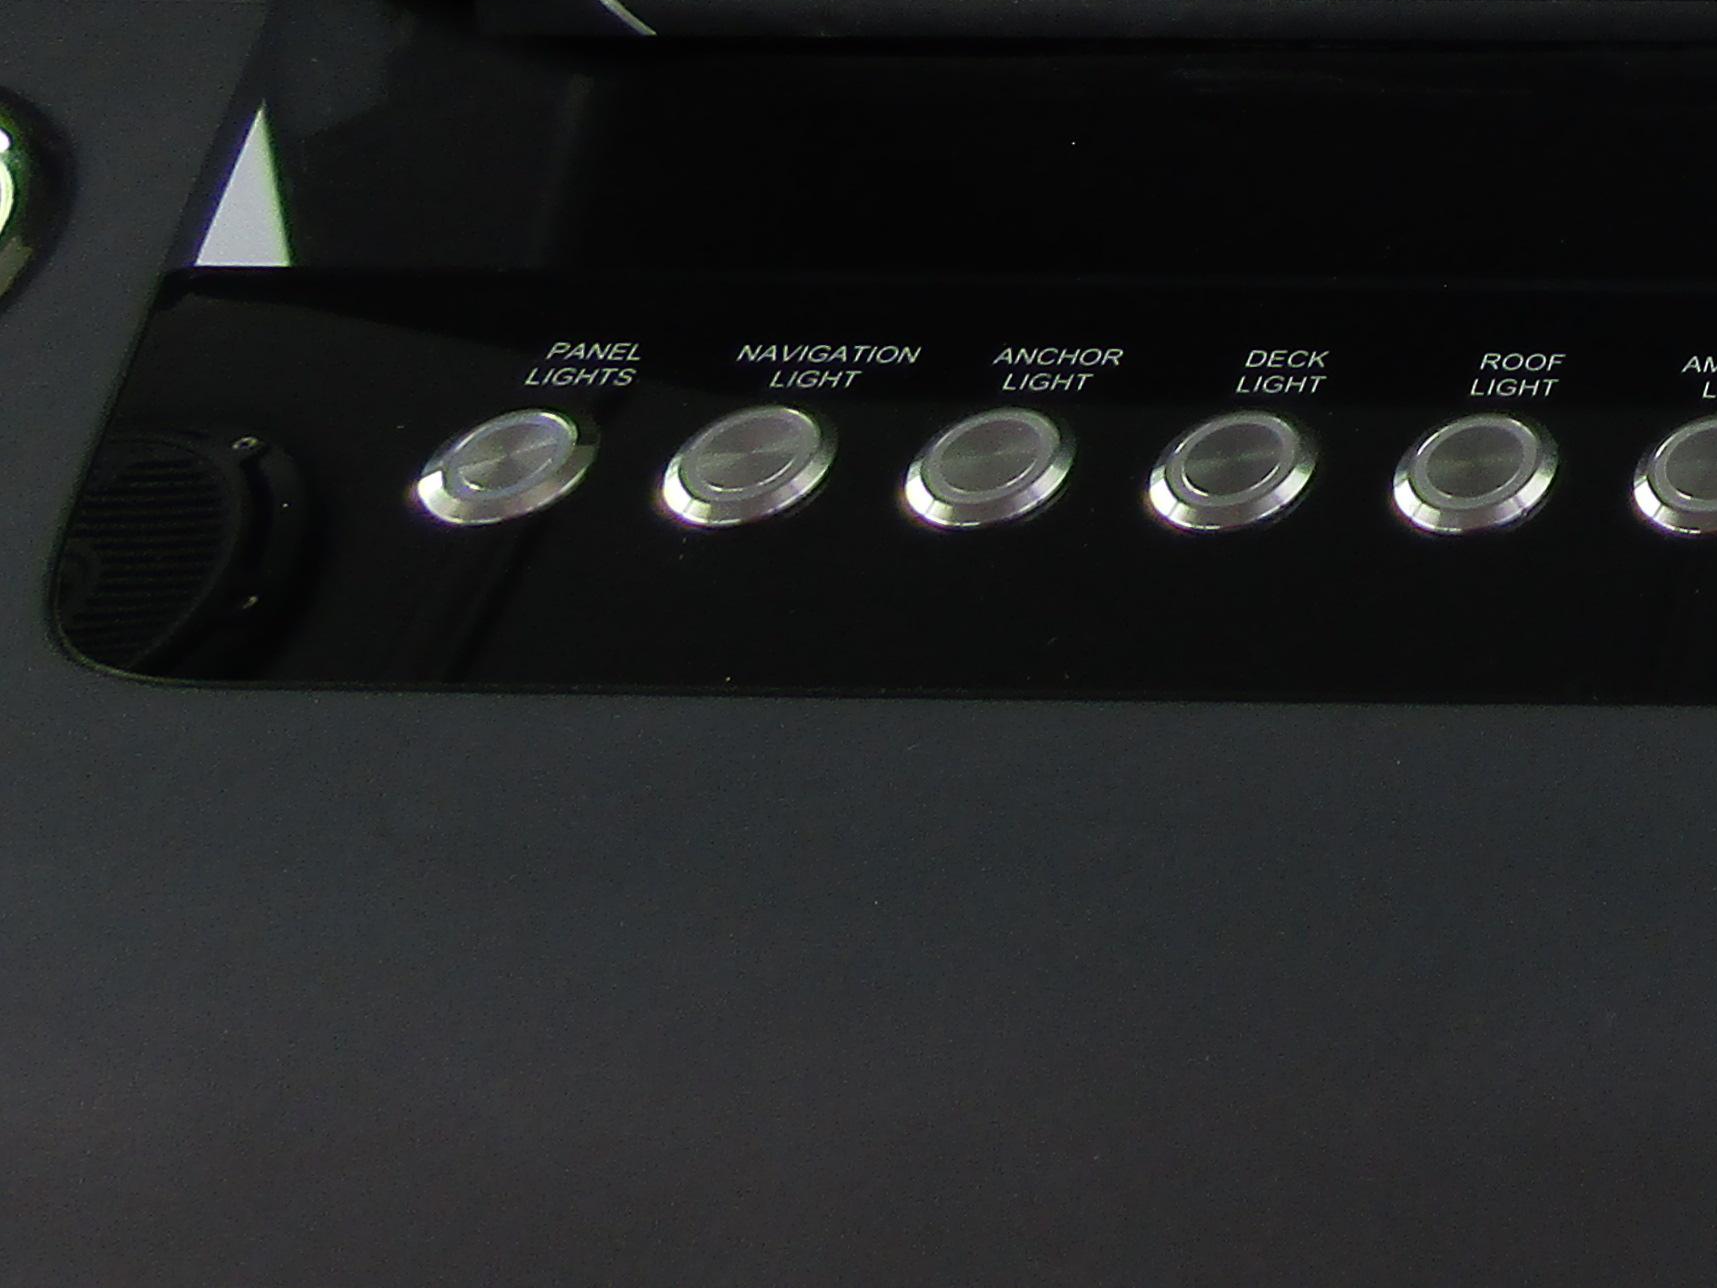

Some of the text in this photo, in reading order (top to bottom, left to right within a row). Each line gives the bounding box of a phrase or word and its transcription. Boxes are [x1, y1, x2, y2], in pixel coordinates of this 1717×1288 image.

[546, 341, 641, 361] PANEL
[736, 344, 922, 364] NAVIGATION
[992, 347, 1124, 366] ANCHOR
[1245, 349, 1329, 368] DECK
[1479, 352, 1566, 372] ROOF
[524, 367, 637, 386] LIGHTS
[769, 369, 862, 389] LIGHT
[1002, 372, 1094, 391] LIGHT
[1236, 375, 1327, 394] LIGHT
[1470, 378, 1559, 397] LIGHT
